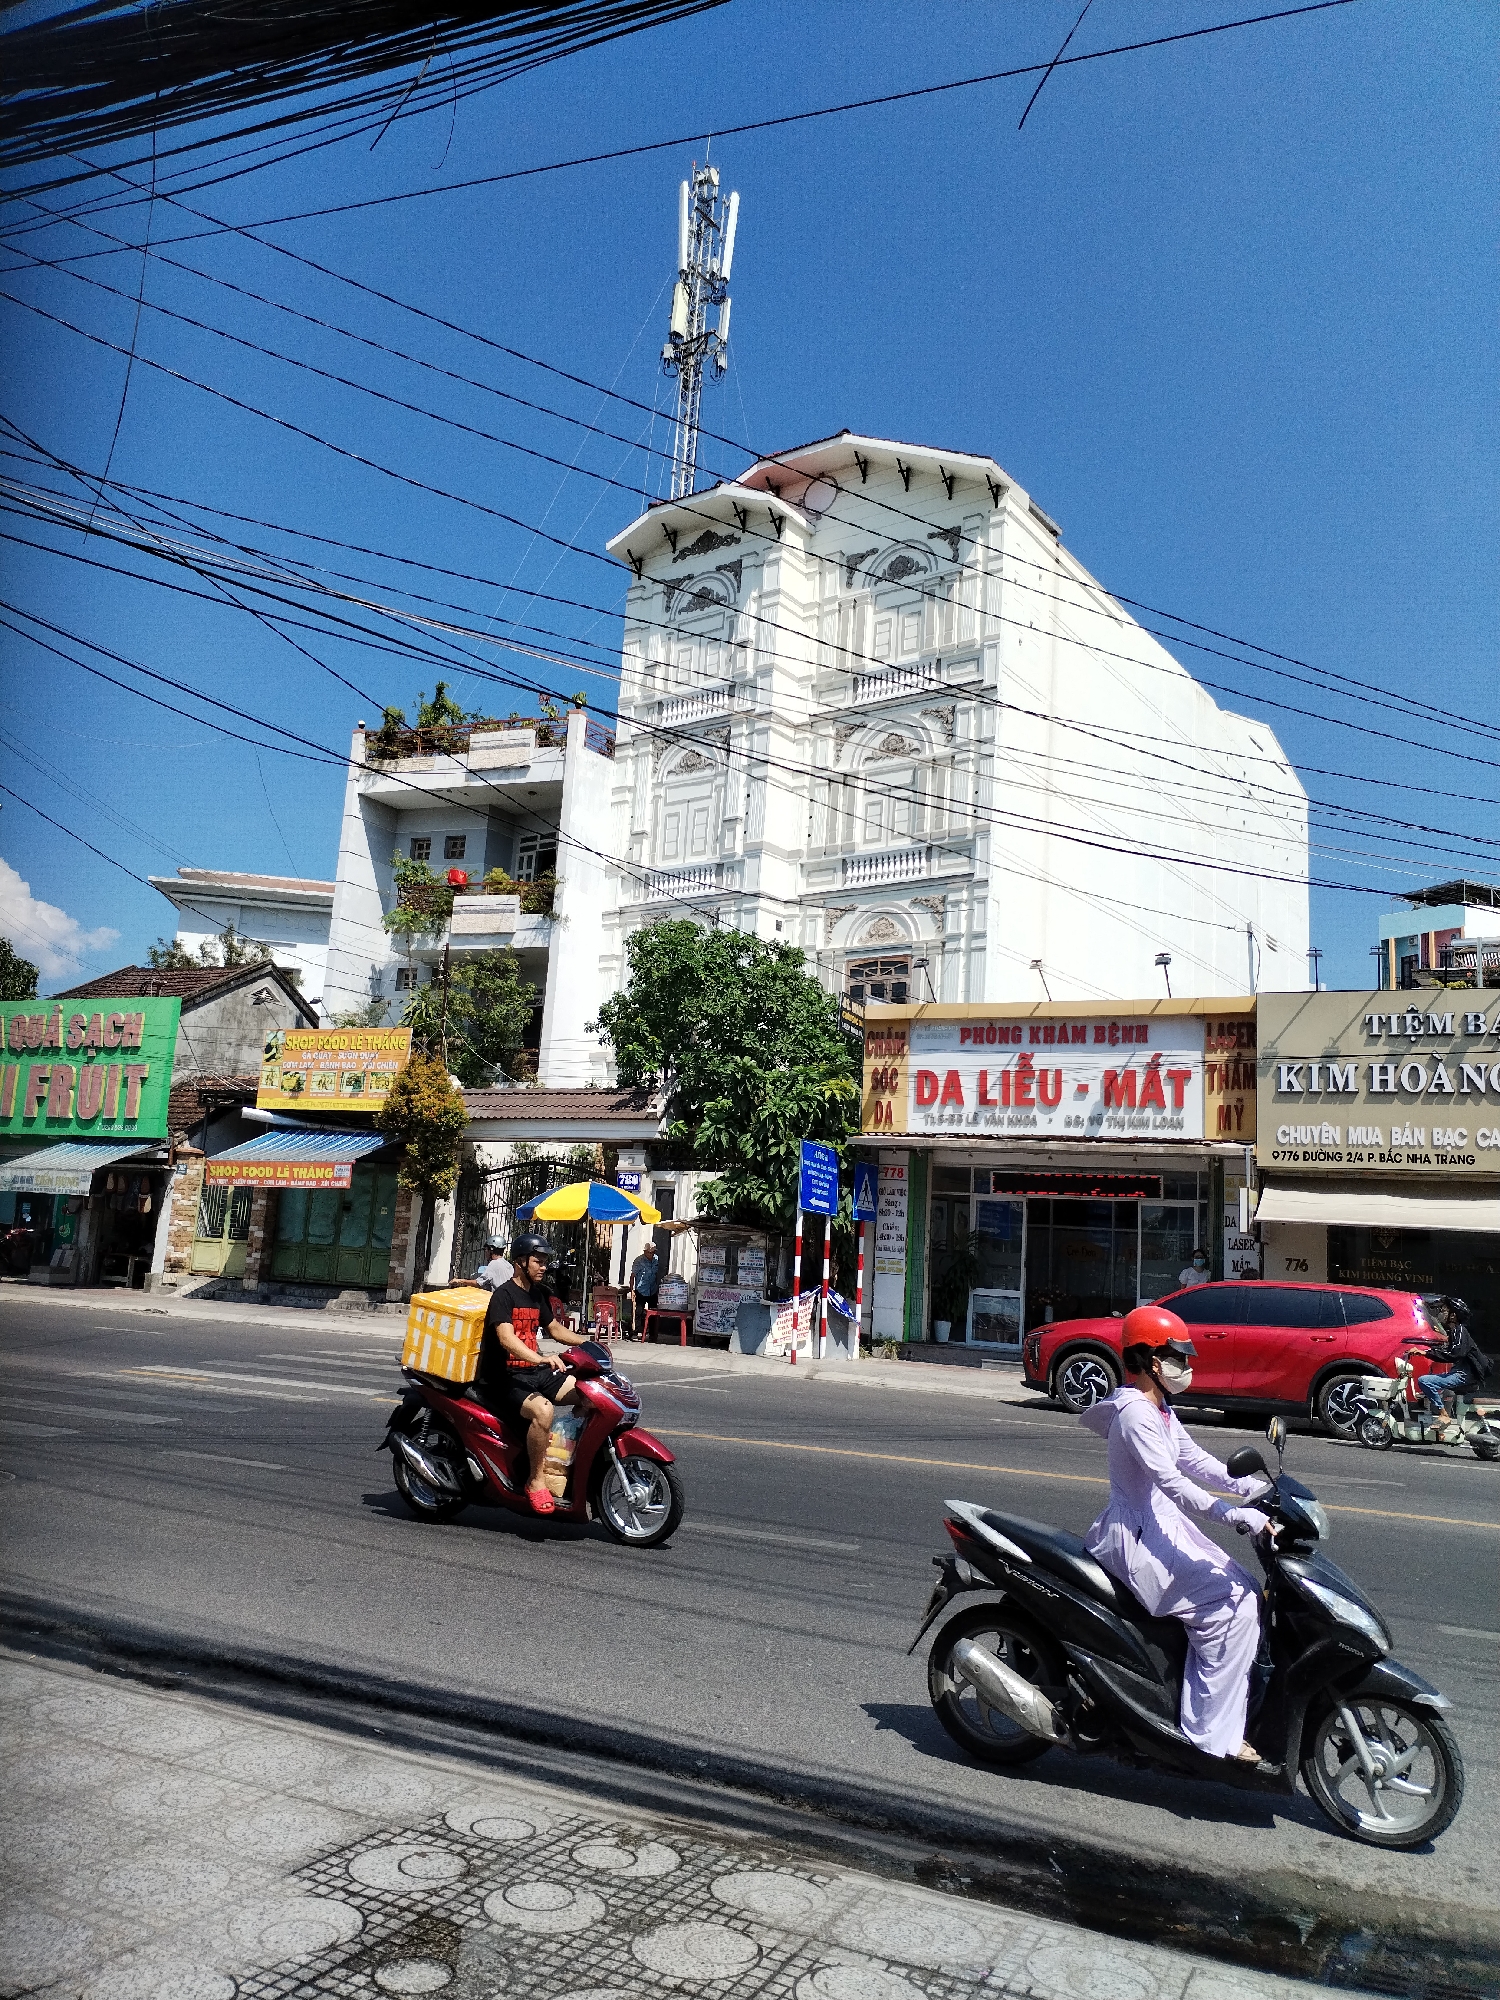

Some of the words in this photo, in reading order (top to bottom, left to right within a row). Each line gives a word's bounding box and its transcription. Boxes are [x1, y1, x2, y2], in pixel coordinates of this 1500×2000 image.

[9, 1004, 63, 1051] QUẢ
[66, 1012, 145, 1057] SẠCH
[1365, 1003, 1455, 1042] TIỆM
[285, 1035, 317, 1051] SHOP
[317, 1034, 349, 1051] FOOD
[960, 1021, 1022, 1045] PHÒNG
[1029, 1020, 1087, 1045] KHÁM
[1094, 1021, 1149, 1047] BỆNH
[916, 1069, 965, 1107] DA
[979, 1052, 1063, 1108] LIỄU
[1103, 1052, 1192, 1109] MẮT
[1278, 1063, 1359, 1093] KIM
[24, 1063, 149, 1119] FRUIT
[874, 1100, 893, 1124] DA
[1277, 1122, 1341, 1145] CHUYÊN
[1347, 1126, 1383, 1146] MUA
[1391, 1121, 1425, 1146] BÁN
[1432, 1127, 1468, 1151] BẠC
[1302, 1148, 1343, 1163] ĐƯỜNG
[1346, 1152, 1364, 1164] 2/4
[1367, 1153, 1377, 1163] P.
[1379, 1148, 1403, 1164] BẮC
[1406, 1153, 1432, 1165] NHA
[1434, 1153, 1476, 1165] TRANG
[209, 1165, 240, 1177] SHOP
[242, 1166, 274, 1178] FOOD
[883, 1167, 904, 1179] 778
[1224, 1215, 1237, 1228] DA
[1227, 1237, 1256, 1252] LASER
[1285, 1257, 1309, 1273] 776
[1338, 1641, 1365, 1658] HONDA
